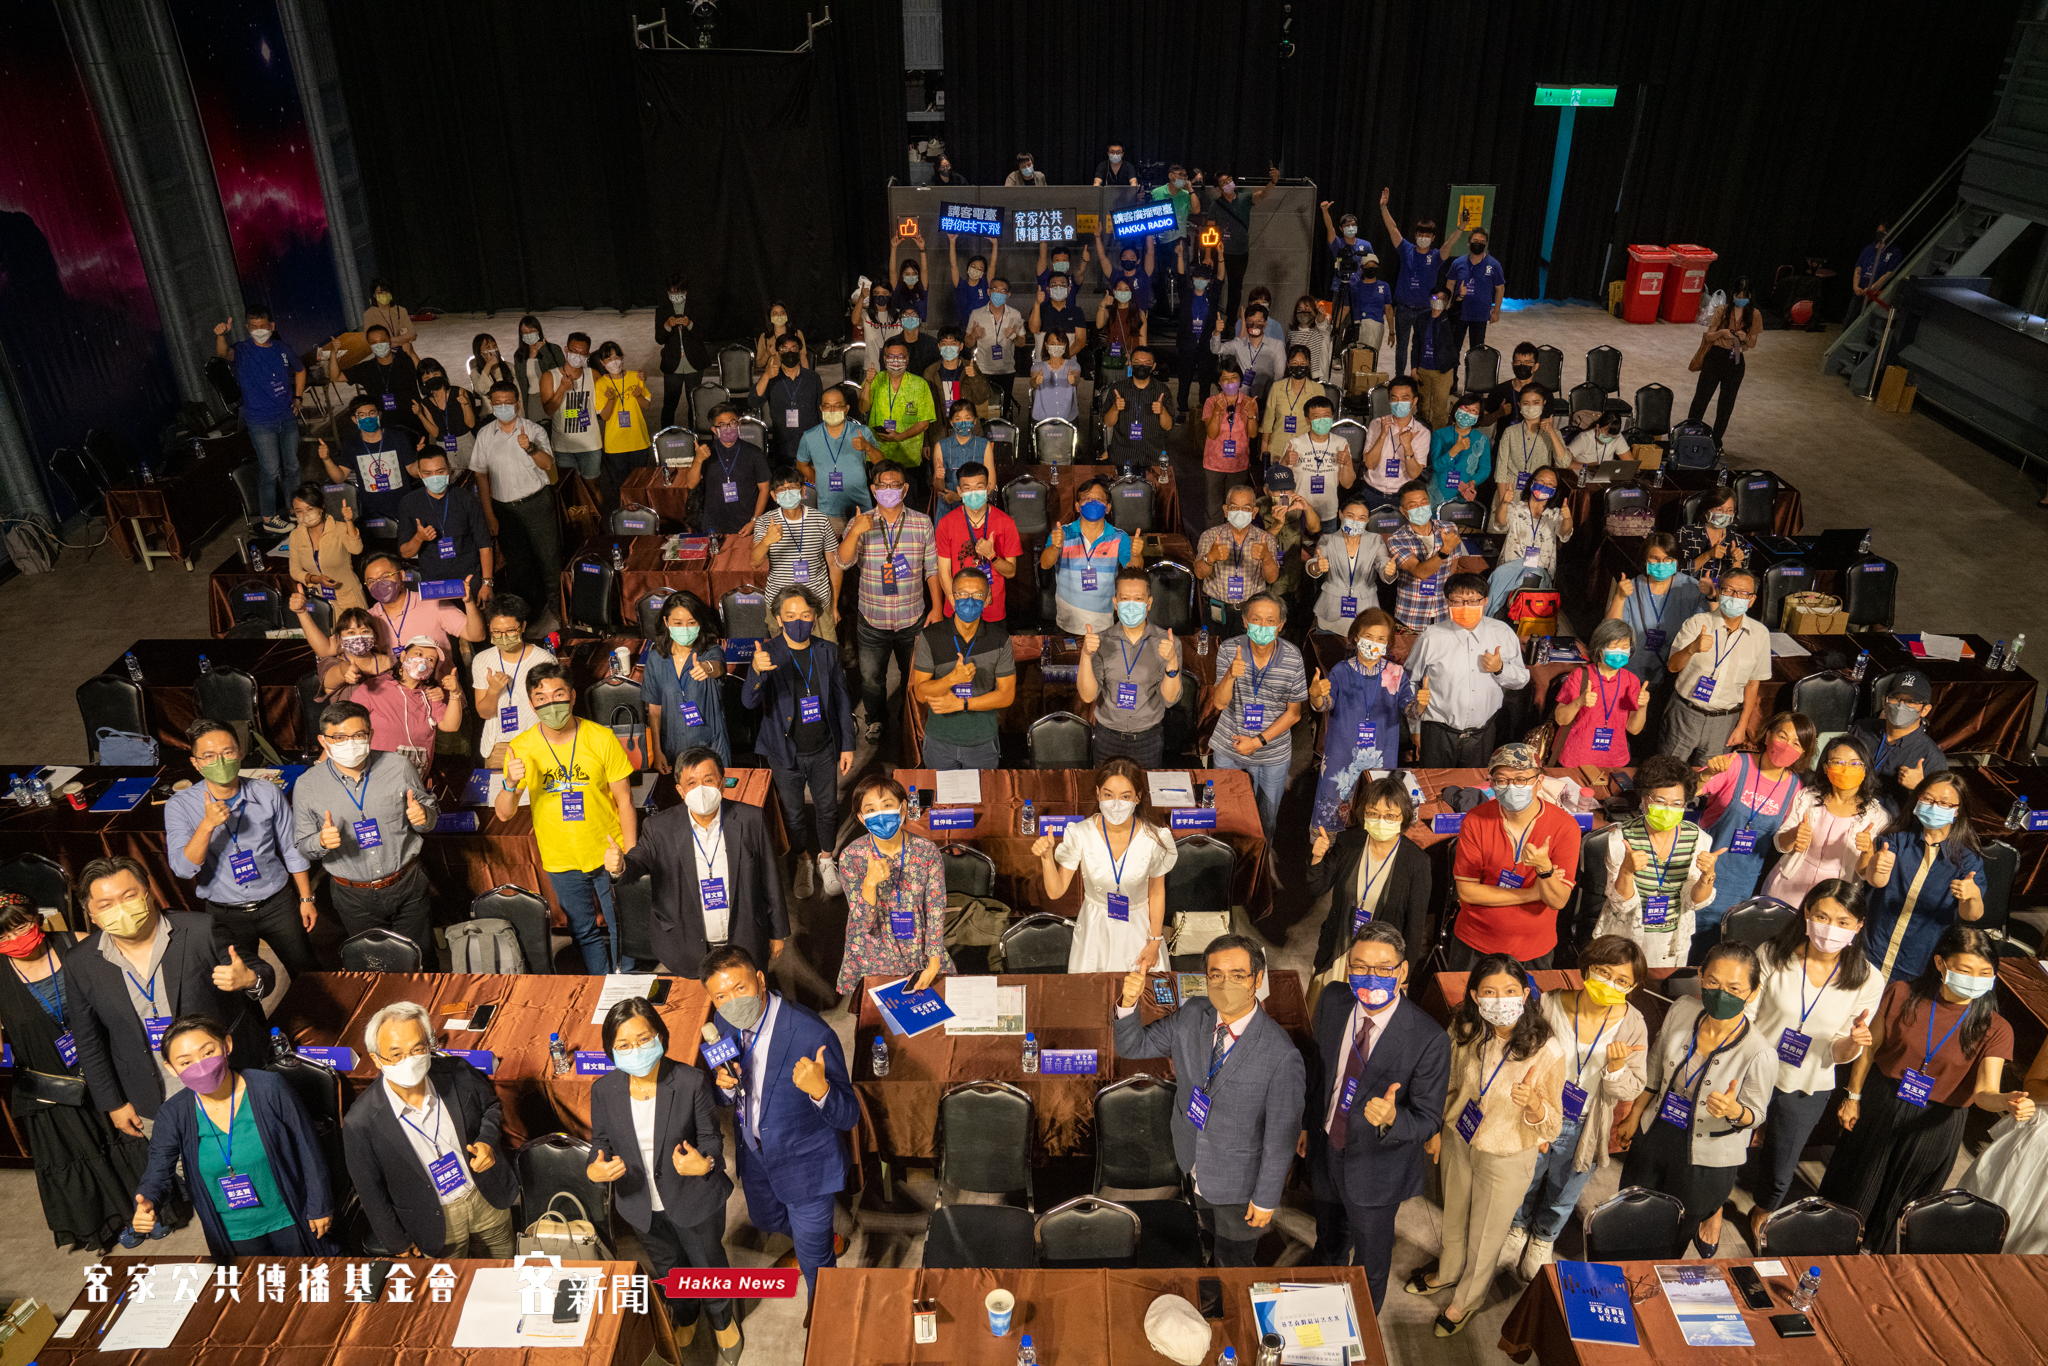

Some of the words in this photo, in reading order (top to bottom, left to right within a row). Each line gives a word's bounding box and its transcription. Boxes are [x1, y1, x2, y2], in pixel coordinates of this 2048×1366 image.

[947, 205, 998, 221] 講客電臺
[1015, 210, 1063, 227] 客家公共
[941, 217, 1001, 235] 帶你共下飛
[1015, 225, 1075, 241] 傳播基金會
[1118, 223, 1146, 236] HAKKA
[1148, 218, 1173, 230] RADIO
